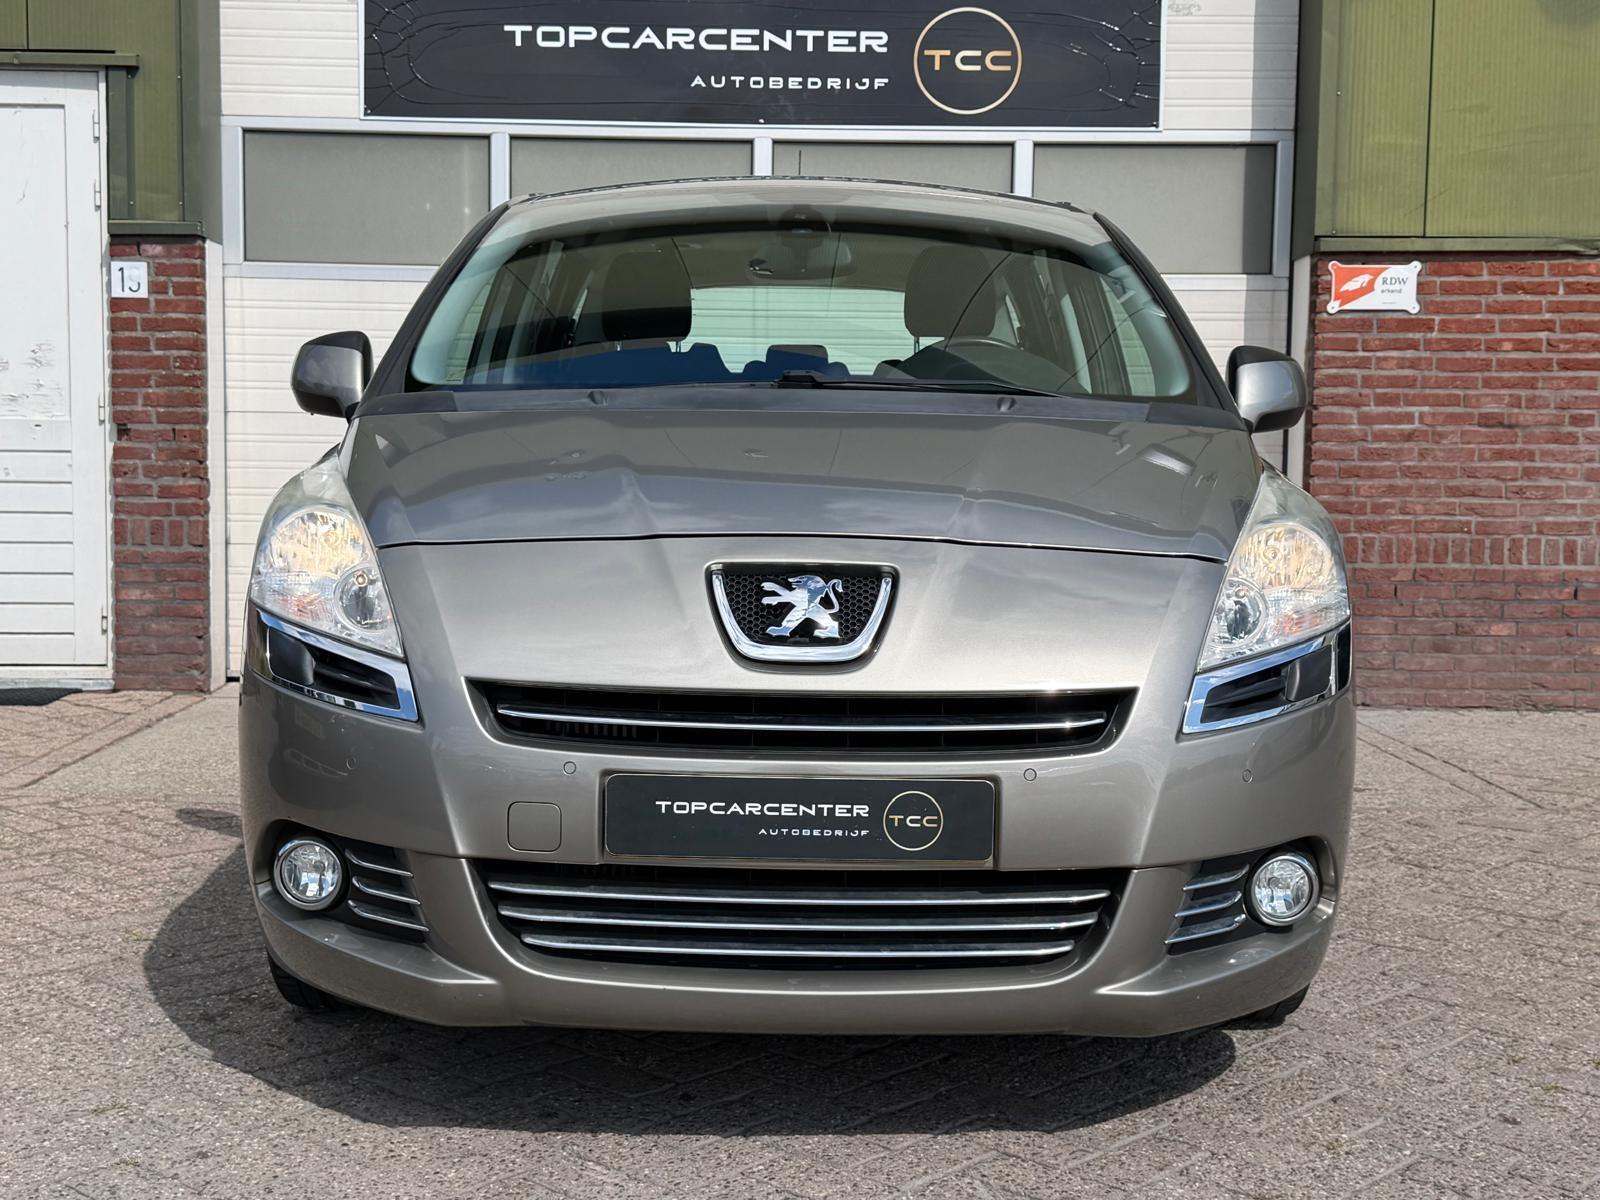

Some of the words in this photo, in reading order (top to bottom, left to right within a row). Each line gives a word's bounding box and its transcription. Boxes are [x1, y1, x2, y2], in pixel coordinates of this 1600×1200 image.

[503, 24, 889, 53] TOPCARCENTER
[924, 49, 1012, 72] TCC
[690, 75, 889, 90] AUTOBEDRIJF
[1381, 276, 1408, 285] RDW
[655, 800, 869, 818] TOPCARCENTER
[888, 815, 938, 827] TCC
[758, 828, 870, 837] AUTOBEDRIJF
